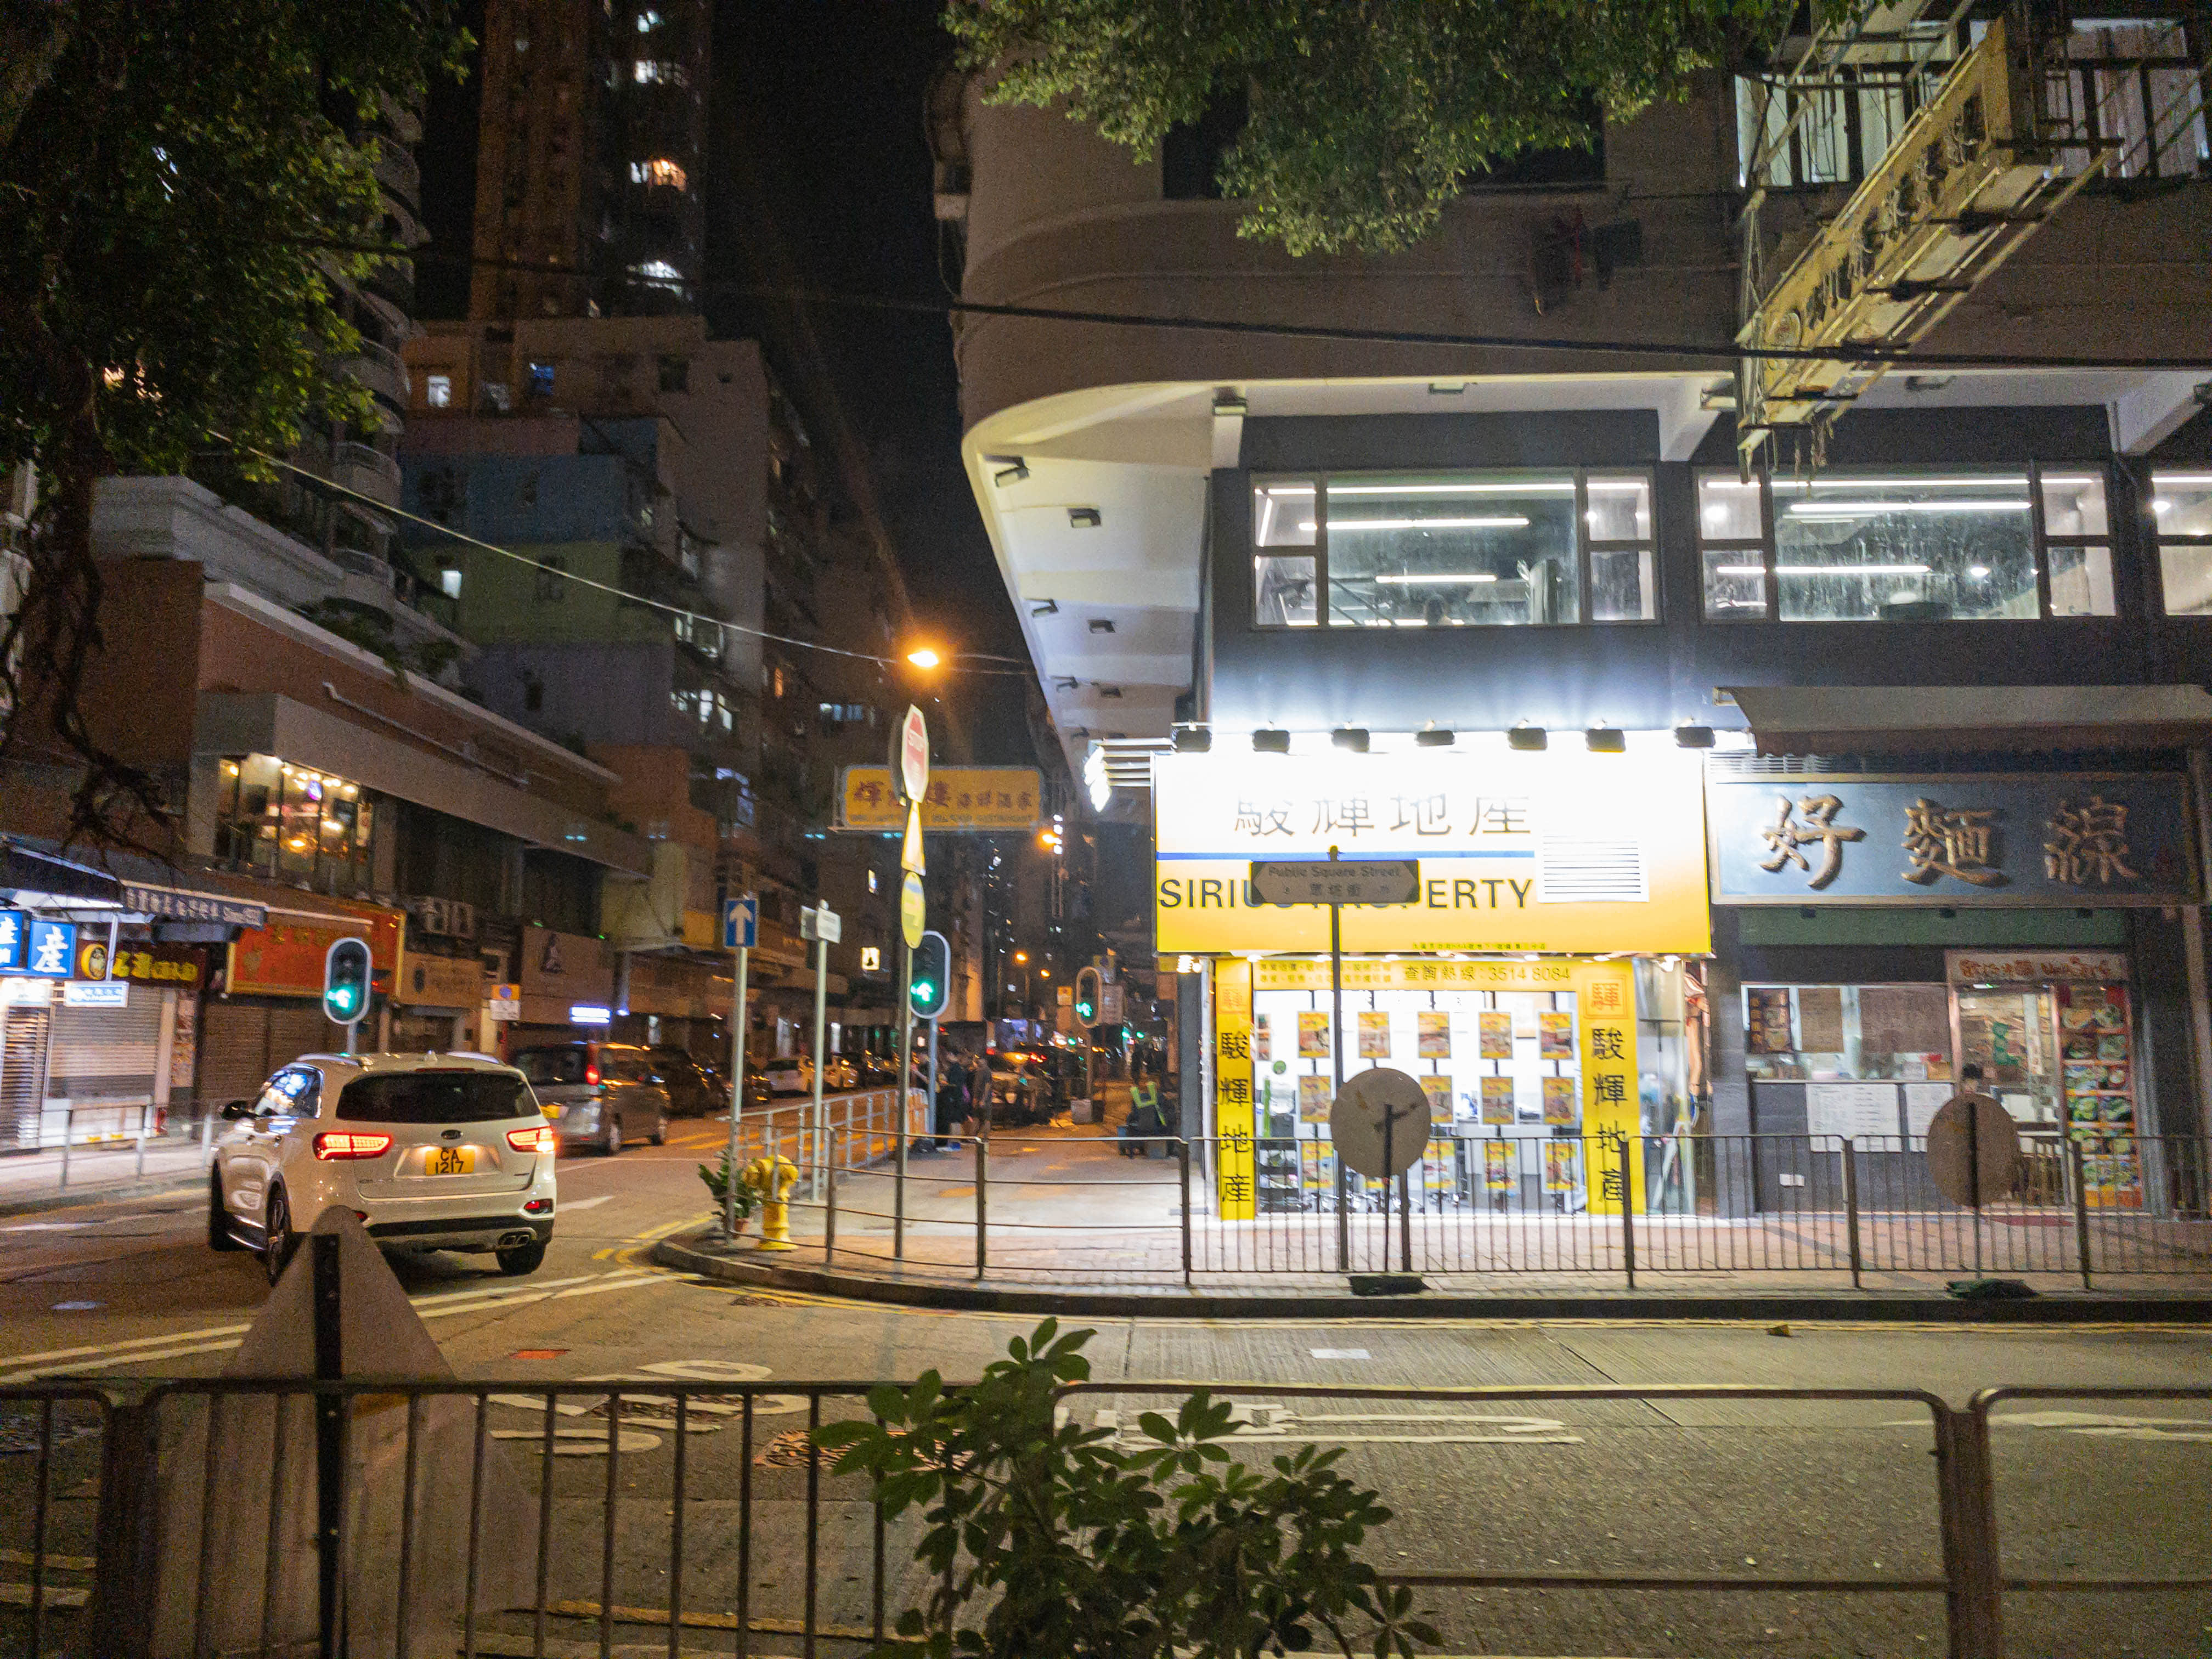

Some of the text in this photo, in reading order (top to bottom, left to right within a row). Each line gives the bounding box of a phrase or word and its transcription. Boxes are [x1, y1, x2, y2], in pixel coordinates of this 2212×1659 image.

[1268, 865, 1401, 878] Public Square Street
[1488, 966, 1527, 981] 3514
[1532, 967, 1571, 981] 8084
[440, 1149, 461, 1161] CA
[435, 1161, 465, 1174] 1217
